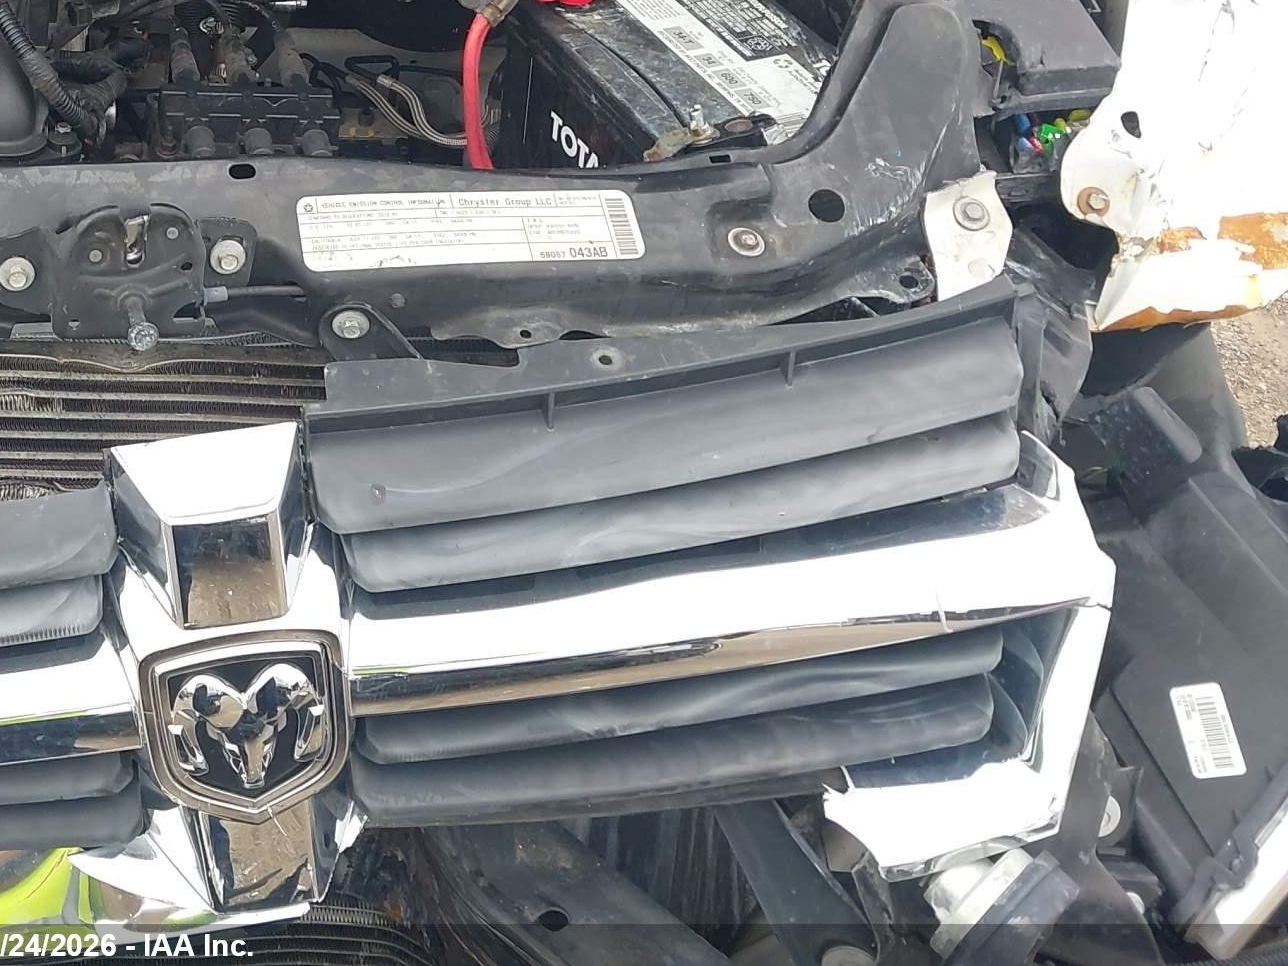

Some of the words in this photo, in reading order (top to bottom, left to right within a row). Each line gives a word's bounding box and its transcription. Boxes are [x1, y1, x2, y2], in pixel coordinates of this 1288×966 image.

[701, 55, 717, 66] 34
[743, 91, 762, 105] 750
[348, 200, 377, 208] EMISSION
[458, 198, 500, 208] Chrysler
[505, 197, 531, 207] Group
[535, 197, 552, 205] LLC
[569, 246, 608, 258] 043AB
